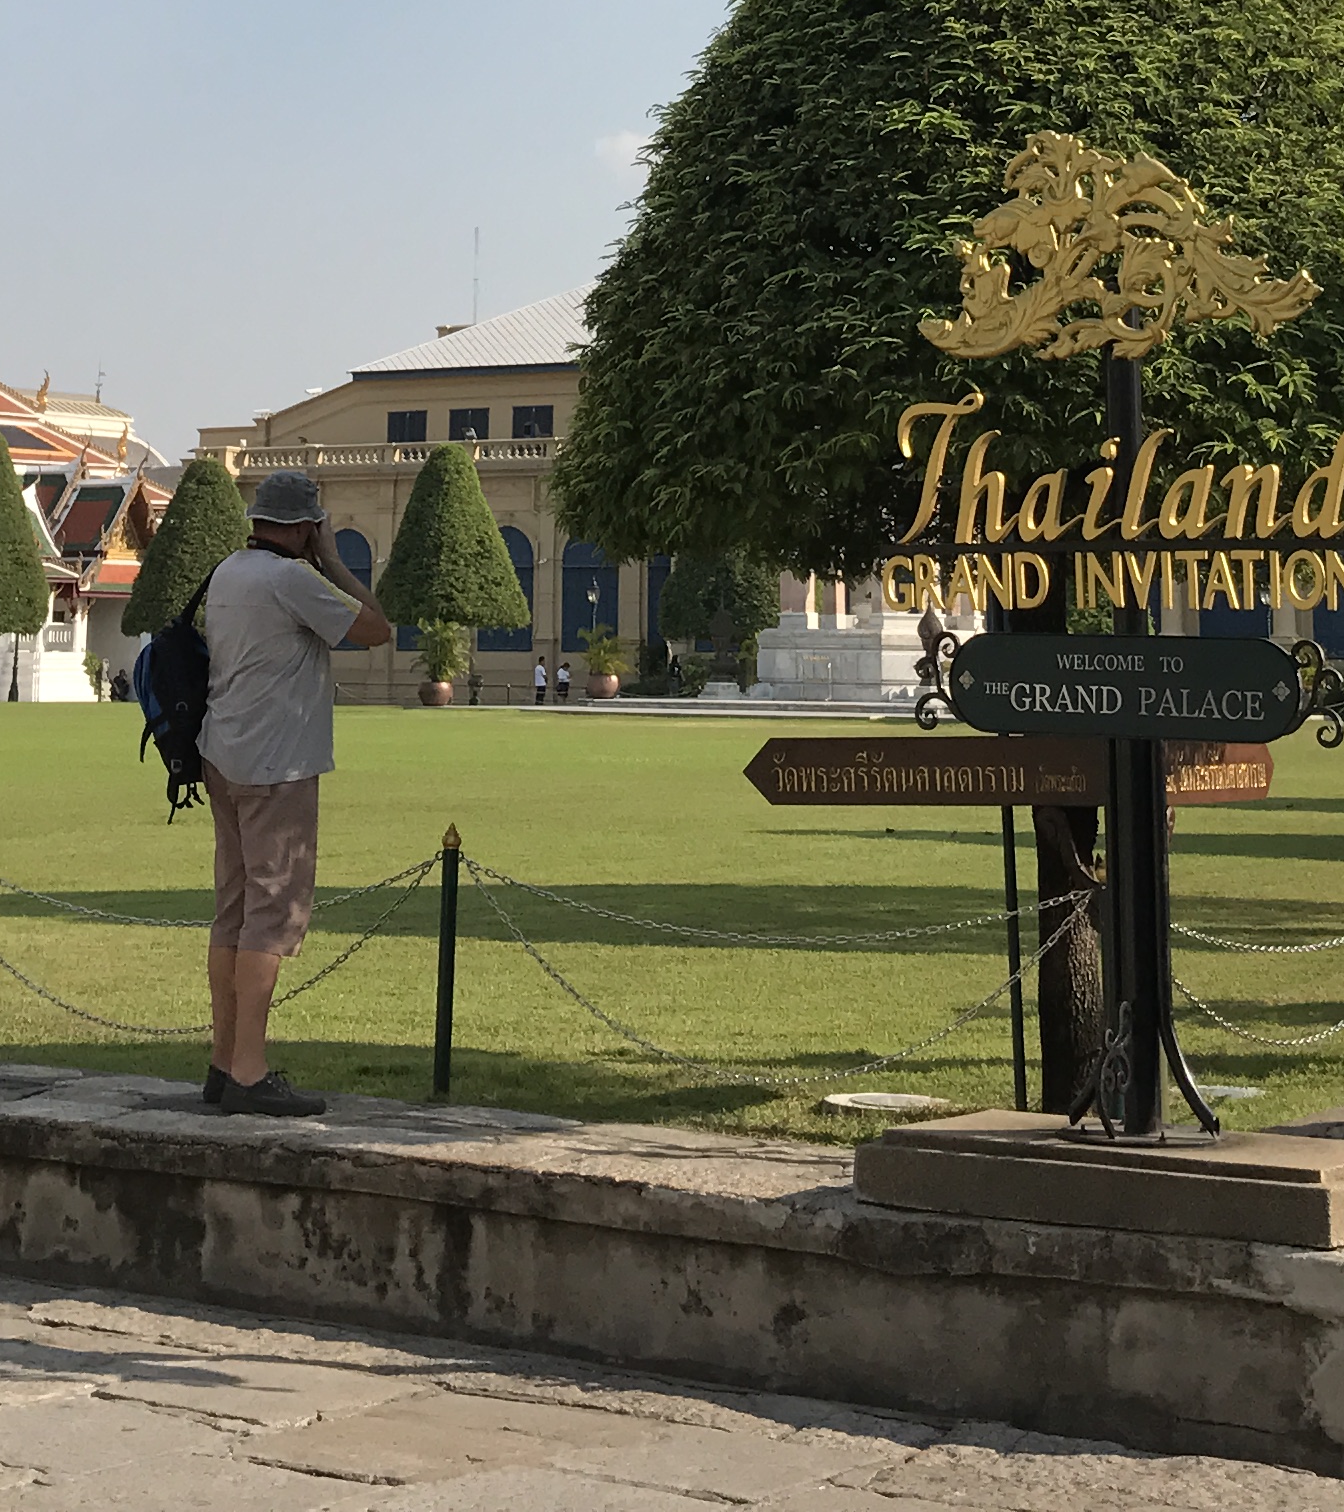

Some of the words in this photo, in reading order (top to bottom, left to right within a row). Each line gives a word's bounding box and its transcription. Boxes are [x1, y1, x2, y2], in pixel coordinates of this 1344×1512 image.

[881, 550, 1050, 611] GRAND
[1056, 653, 1145, 672] WELCOME
[1159, 656, 1184, 673] TO
[984, 681, 1010, 695] THE
[1010, 682, 1123, 715] GRAND
[1138, 687, 1265, 721] PALACE
